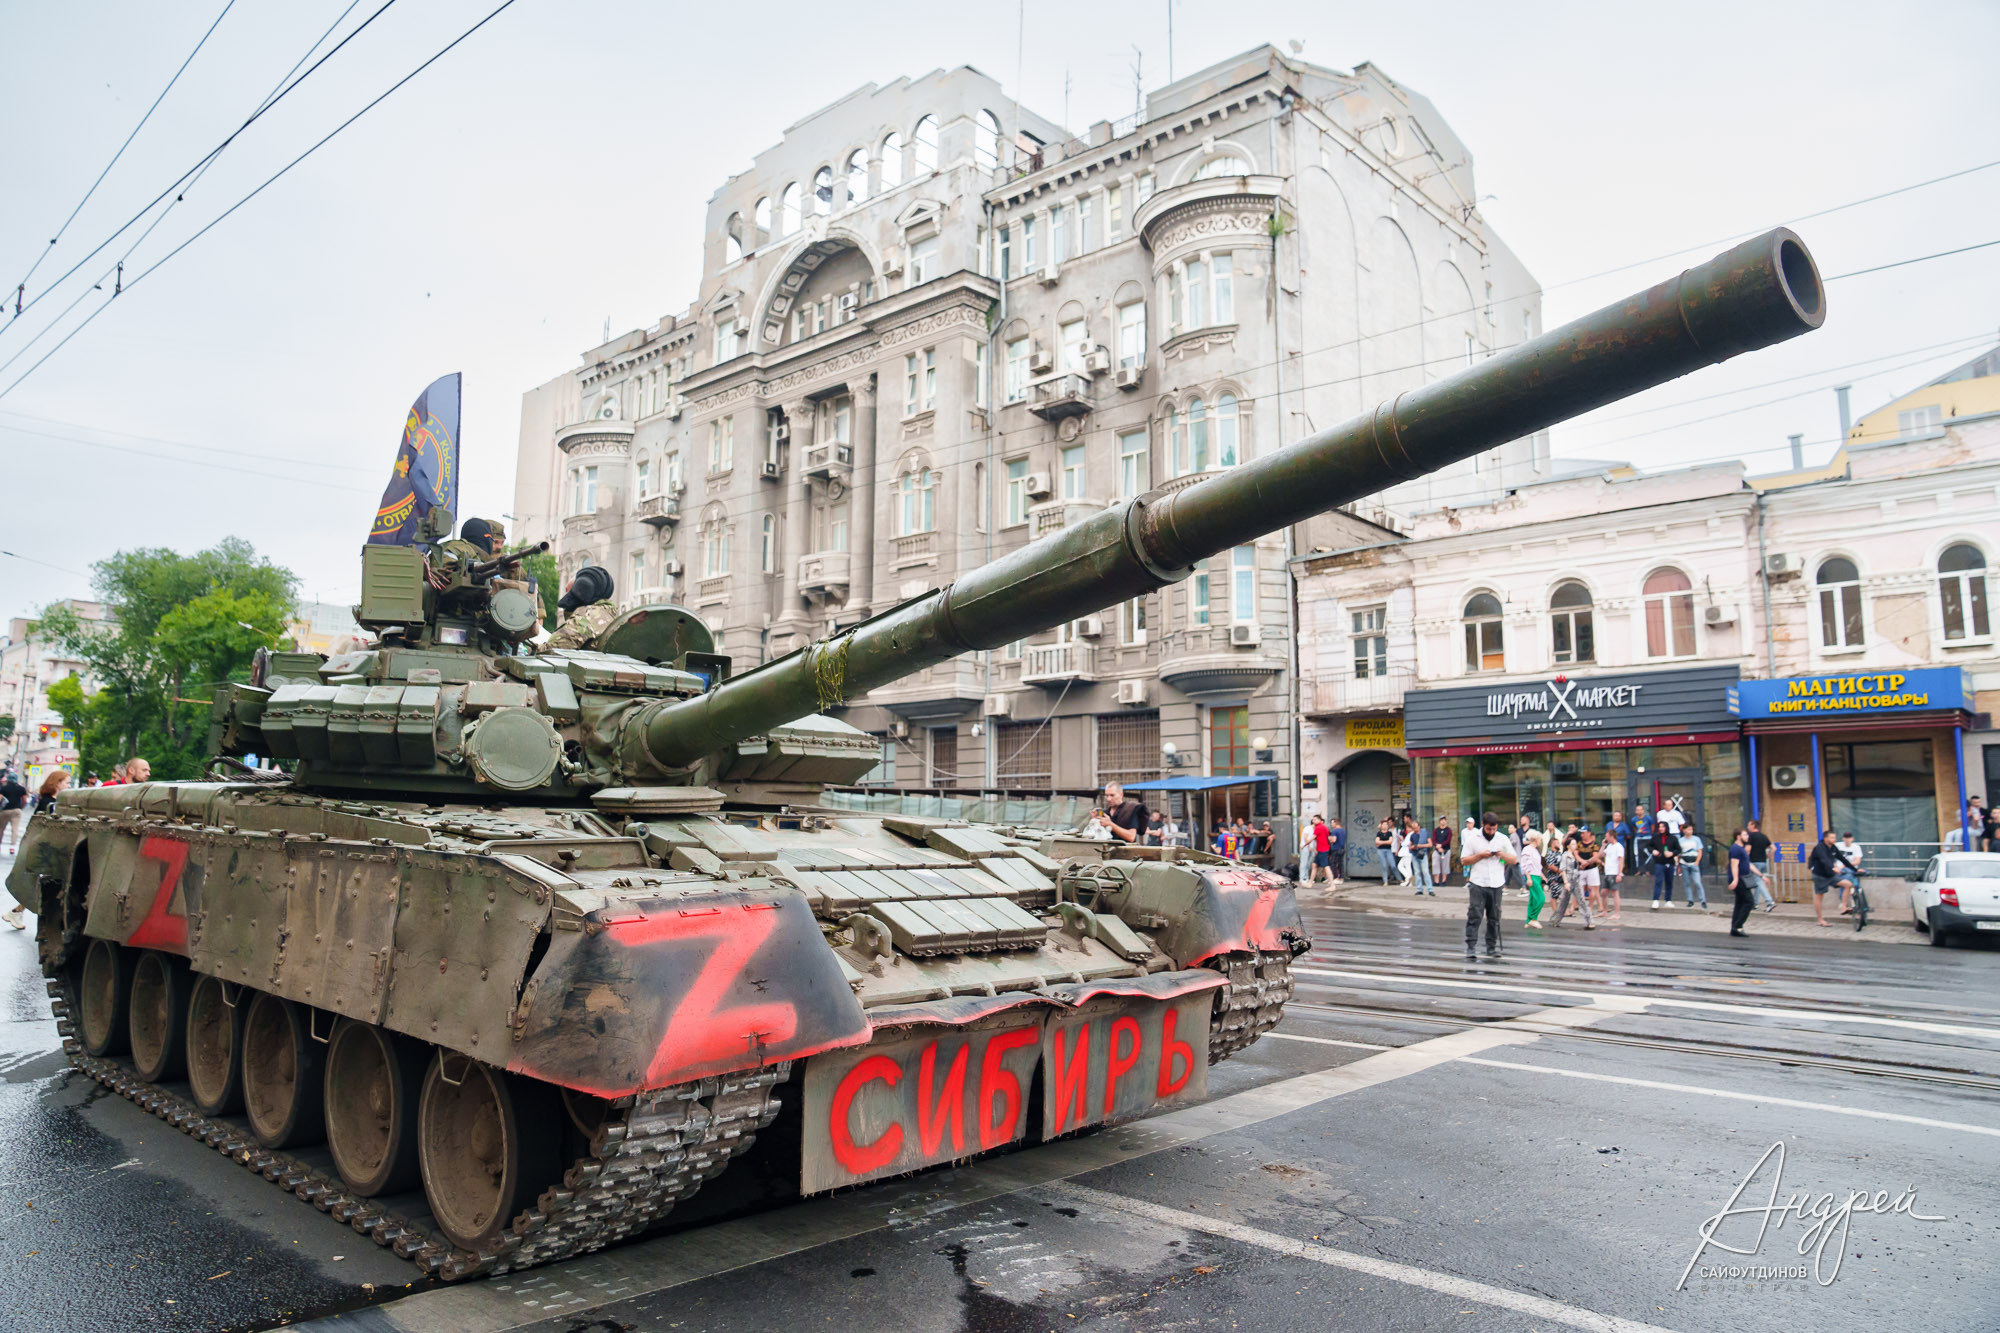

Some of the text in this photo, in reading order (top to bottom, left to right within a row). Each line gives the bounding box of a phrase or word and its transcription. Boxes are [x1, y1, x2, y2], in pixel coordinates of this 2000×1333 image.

[1487, 691, 1548, 719] ШАУРМА
[1575, 685, 1642, 708] МАРКЕТ
[1787, 674, 1905, 697] МАГИСТР
[1769, 693, 1928, 713] КНИГИ-КАНЦТОВАРЫ
[1353, 721, 1396, 729] ПРОДАЮ
[128, 832, 191, 946] Z
[602, 902, 798, 1085] Z
[829, 1007, 1196, 1176] СИБИРЬ
